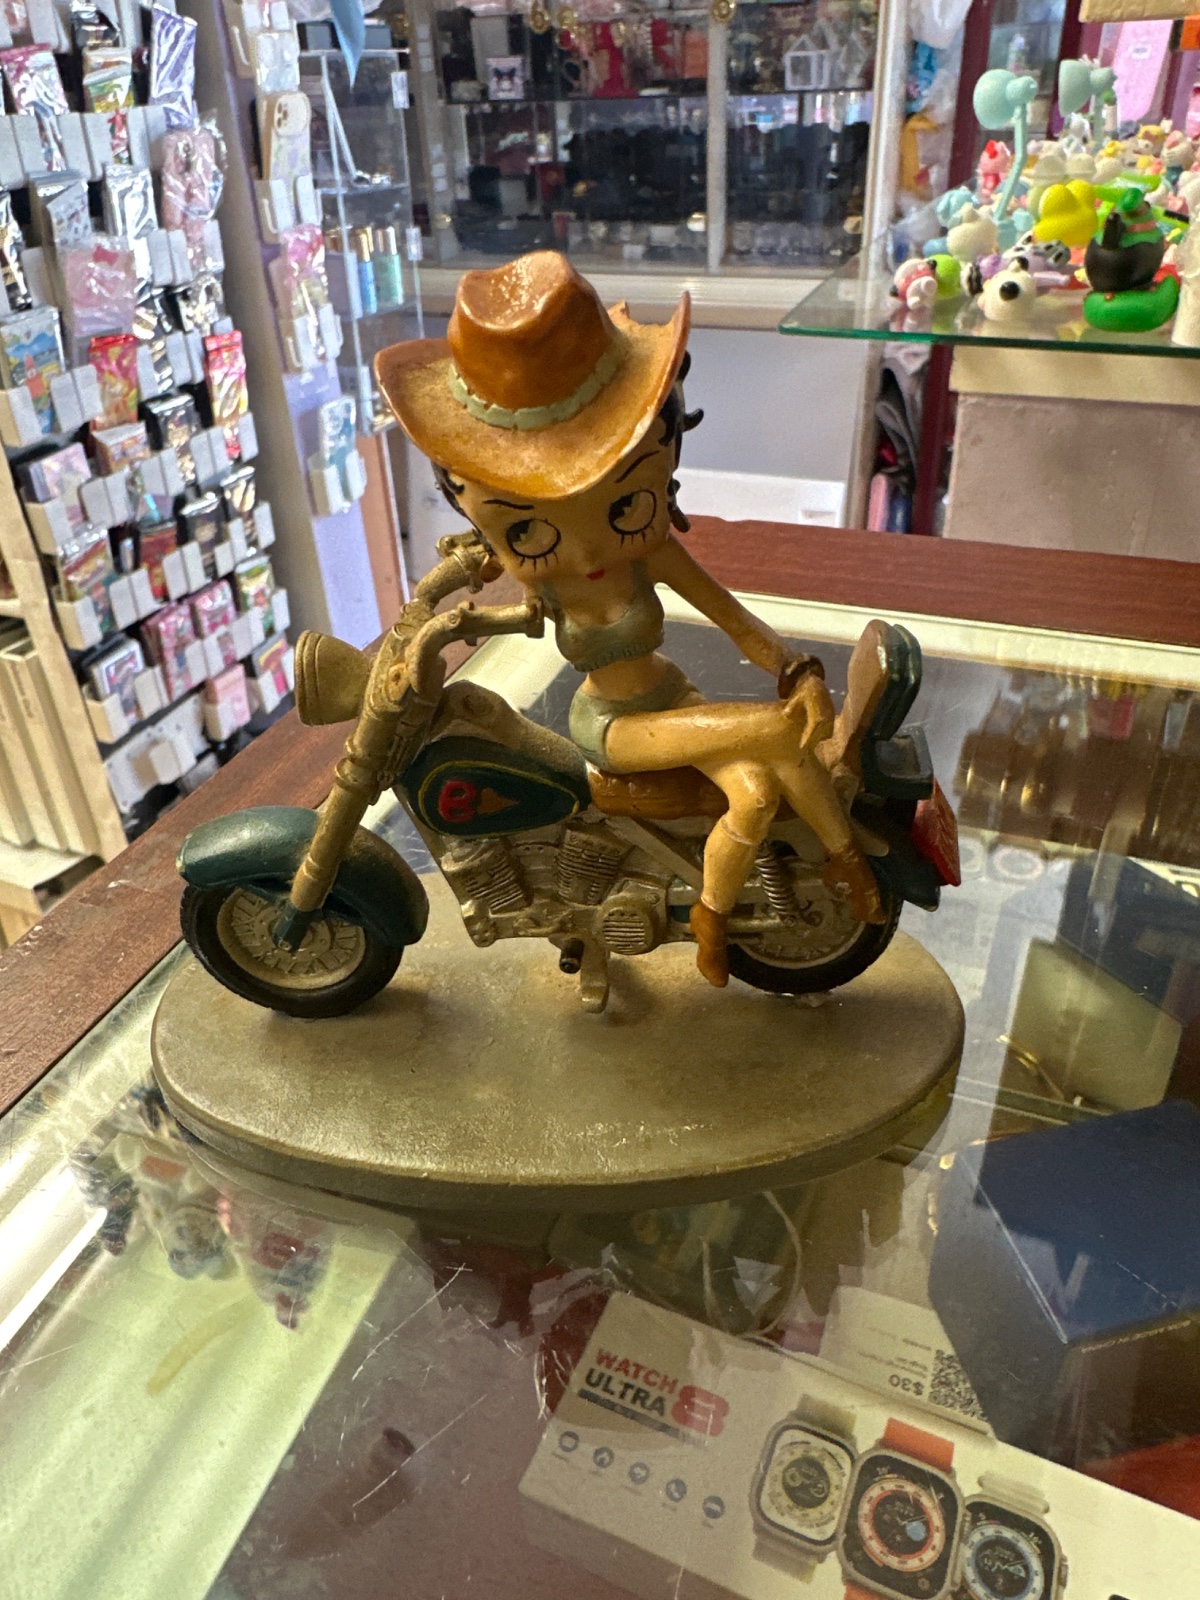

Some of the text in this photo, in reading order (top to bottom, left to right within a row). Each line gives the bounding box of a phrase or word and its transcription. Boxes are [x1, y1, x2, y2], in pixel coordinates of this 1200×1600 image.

[585, 1367, 666, 1417] ULTRA
[595, 1349, 679, 1394] WATCH
[888, 1374, 925, 1397] $30
